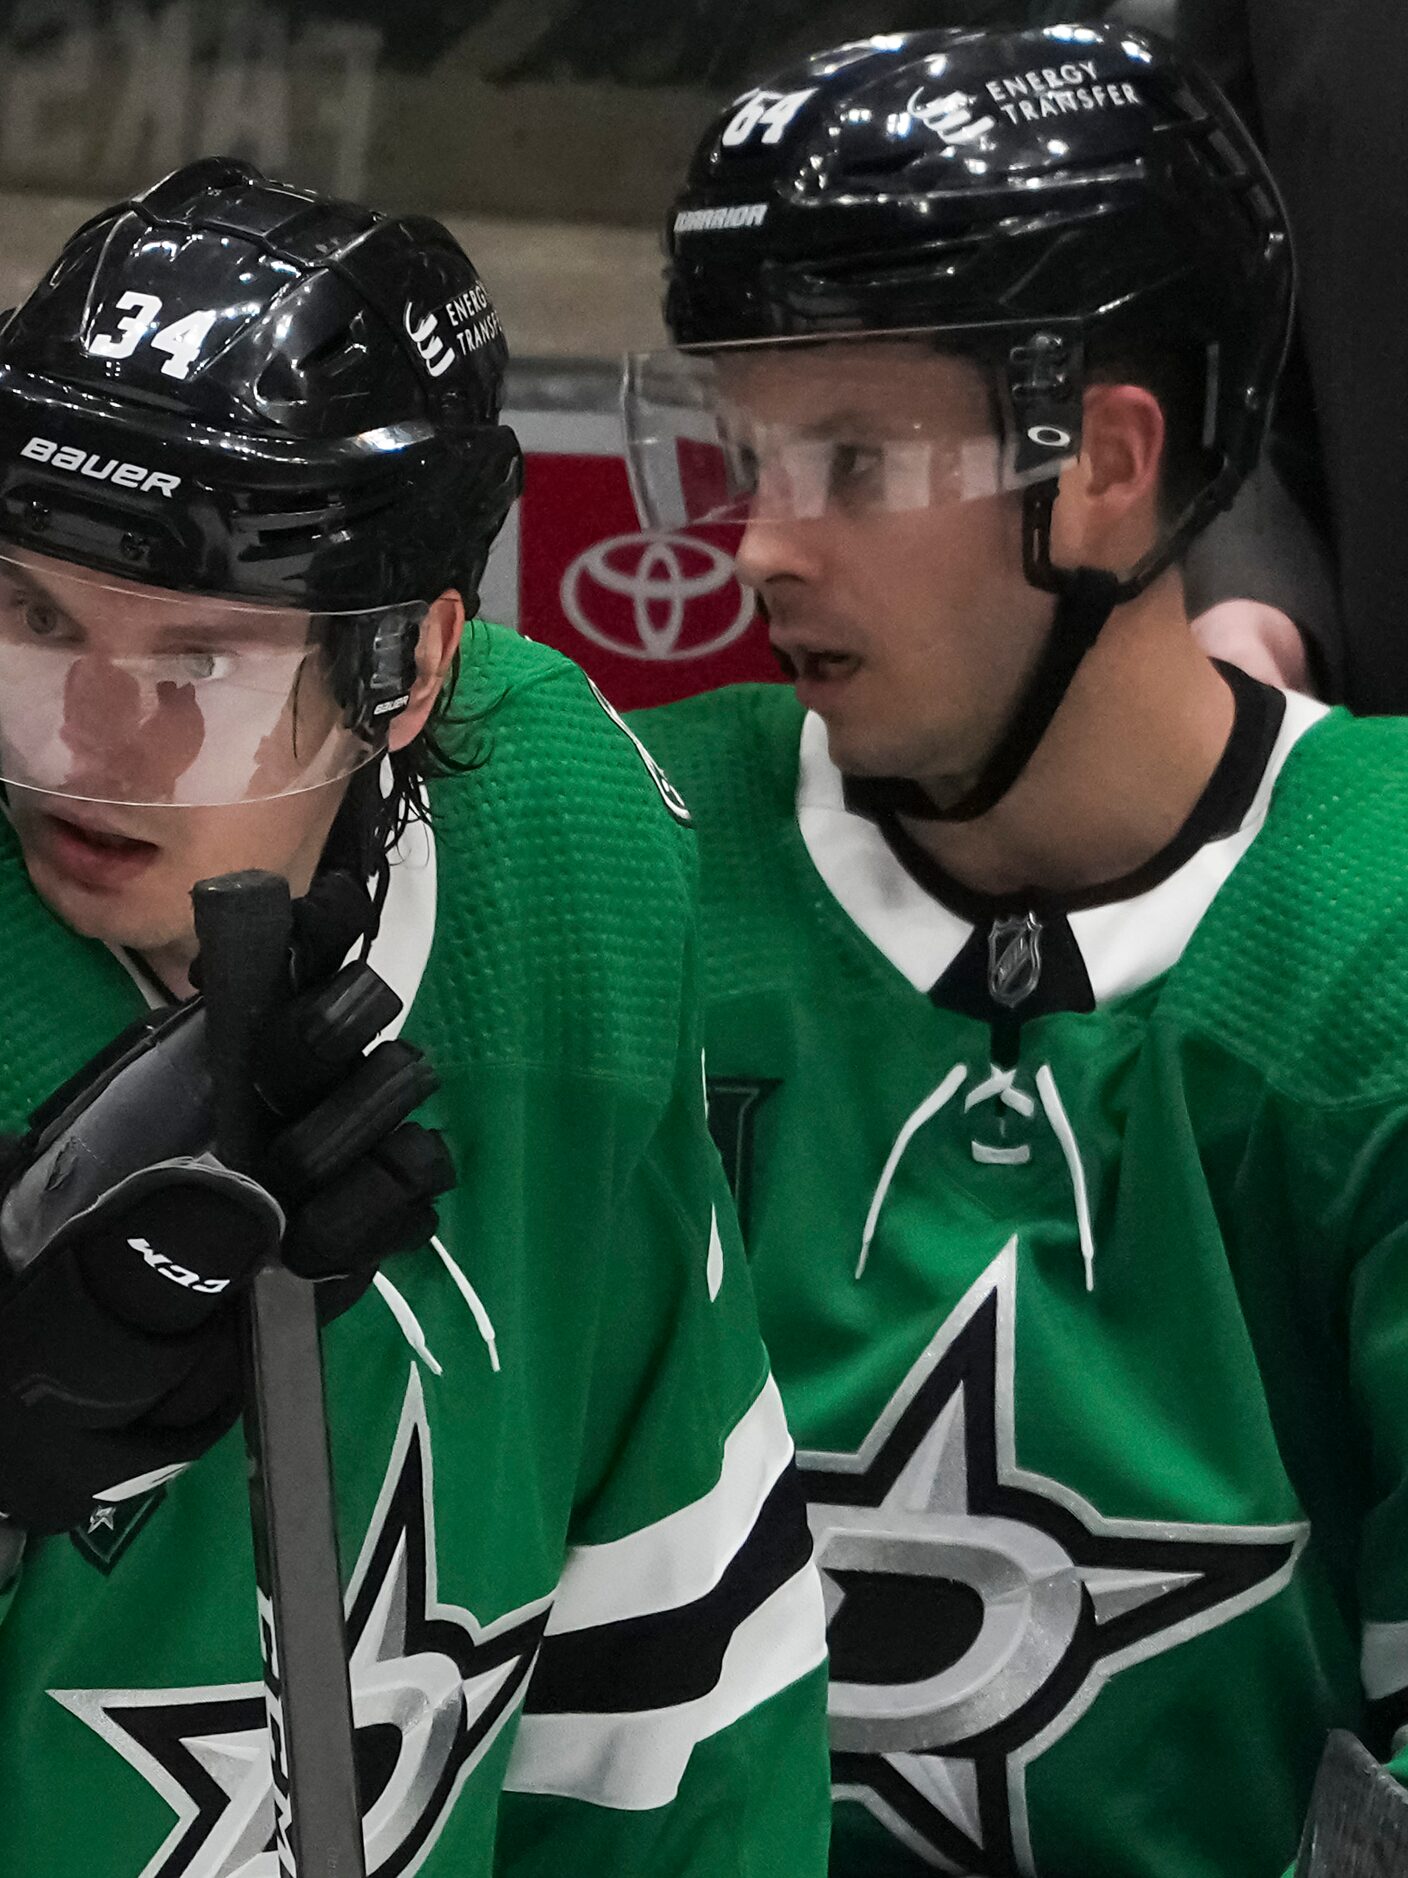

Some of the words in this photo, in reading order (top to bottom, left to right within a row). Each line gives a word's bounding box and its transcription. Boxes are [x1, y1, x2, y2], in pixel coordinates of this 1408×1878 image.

[986, 61, 1098, 101] ENERGY
[1000, 83, 1139, 124] TRANSFER
[722, 87, 819, 146] 64
[88, 290, 217, 380] 34
[126, 1238, 231, 1293] CCM
